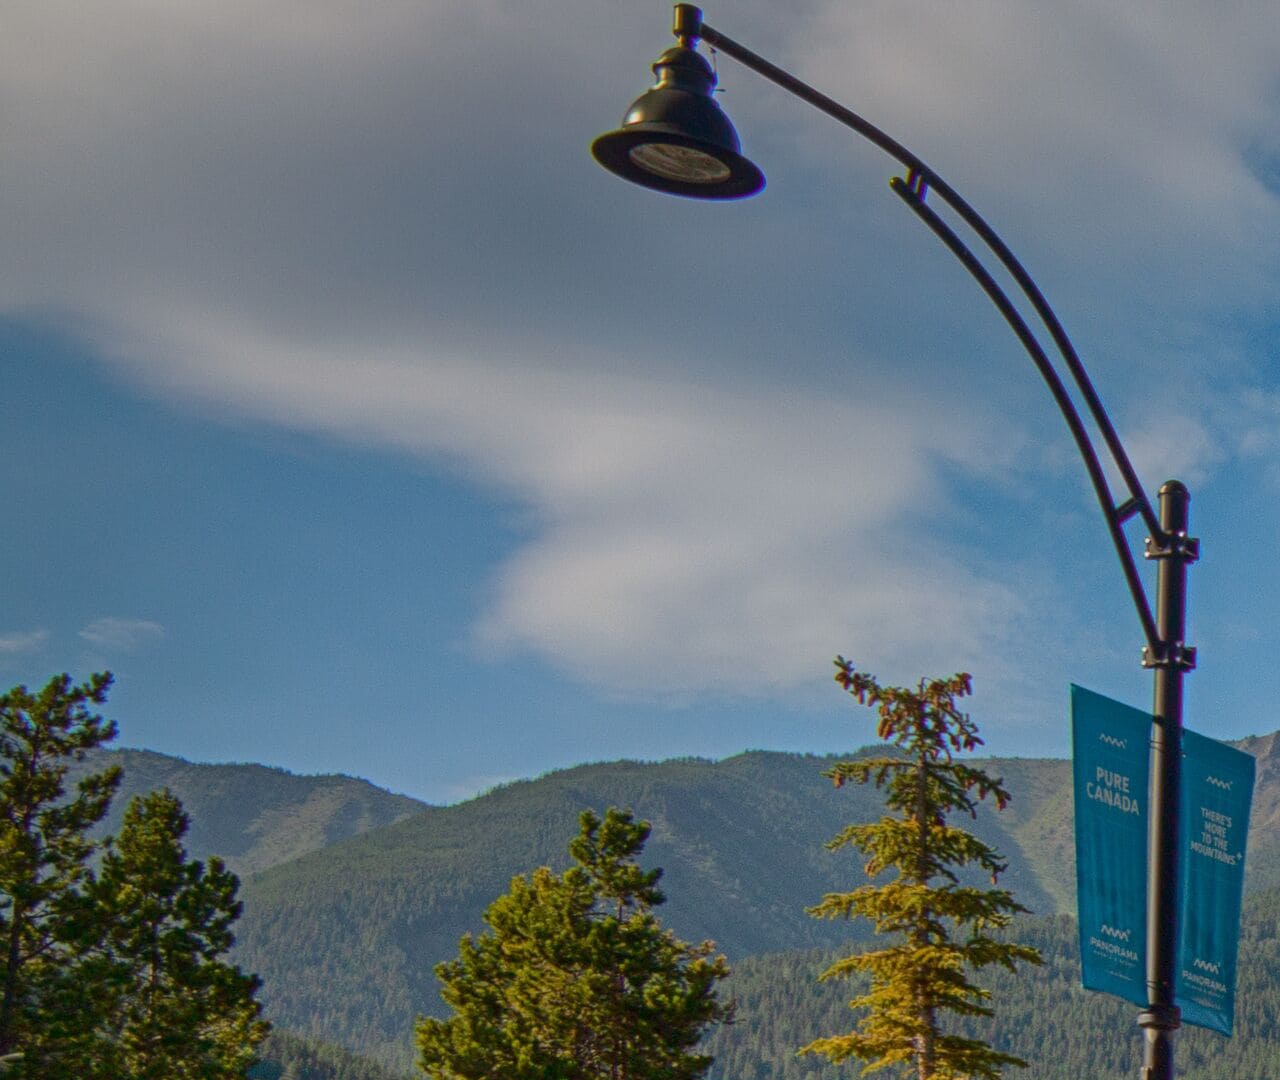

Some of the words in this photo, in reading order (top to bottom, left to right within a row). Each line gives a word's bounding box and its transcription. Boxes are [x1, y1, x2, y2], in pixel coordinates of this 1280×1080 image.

[1096, 766, 1130, 793] PURE
[1086, 781, 1140, 816] CANADA
[1201, 807, 1233, 828] THERE'S
[1204, 821, 1227, 838] MORE
[1201, 831, 1212, 846] TO
[1214, 836, 1229, 852] THE
[1090, 936, 1139, 961] PANORAMA
[1182, 970, 1227, 993] PANORAMA
